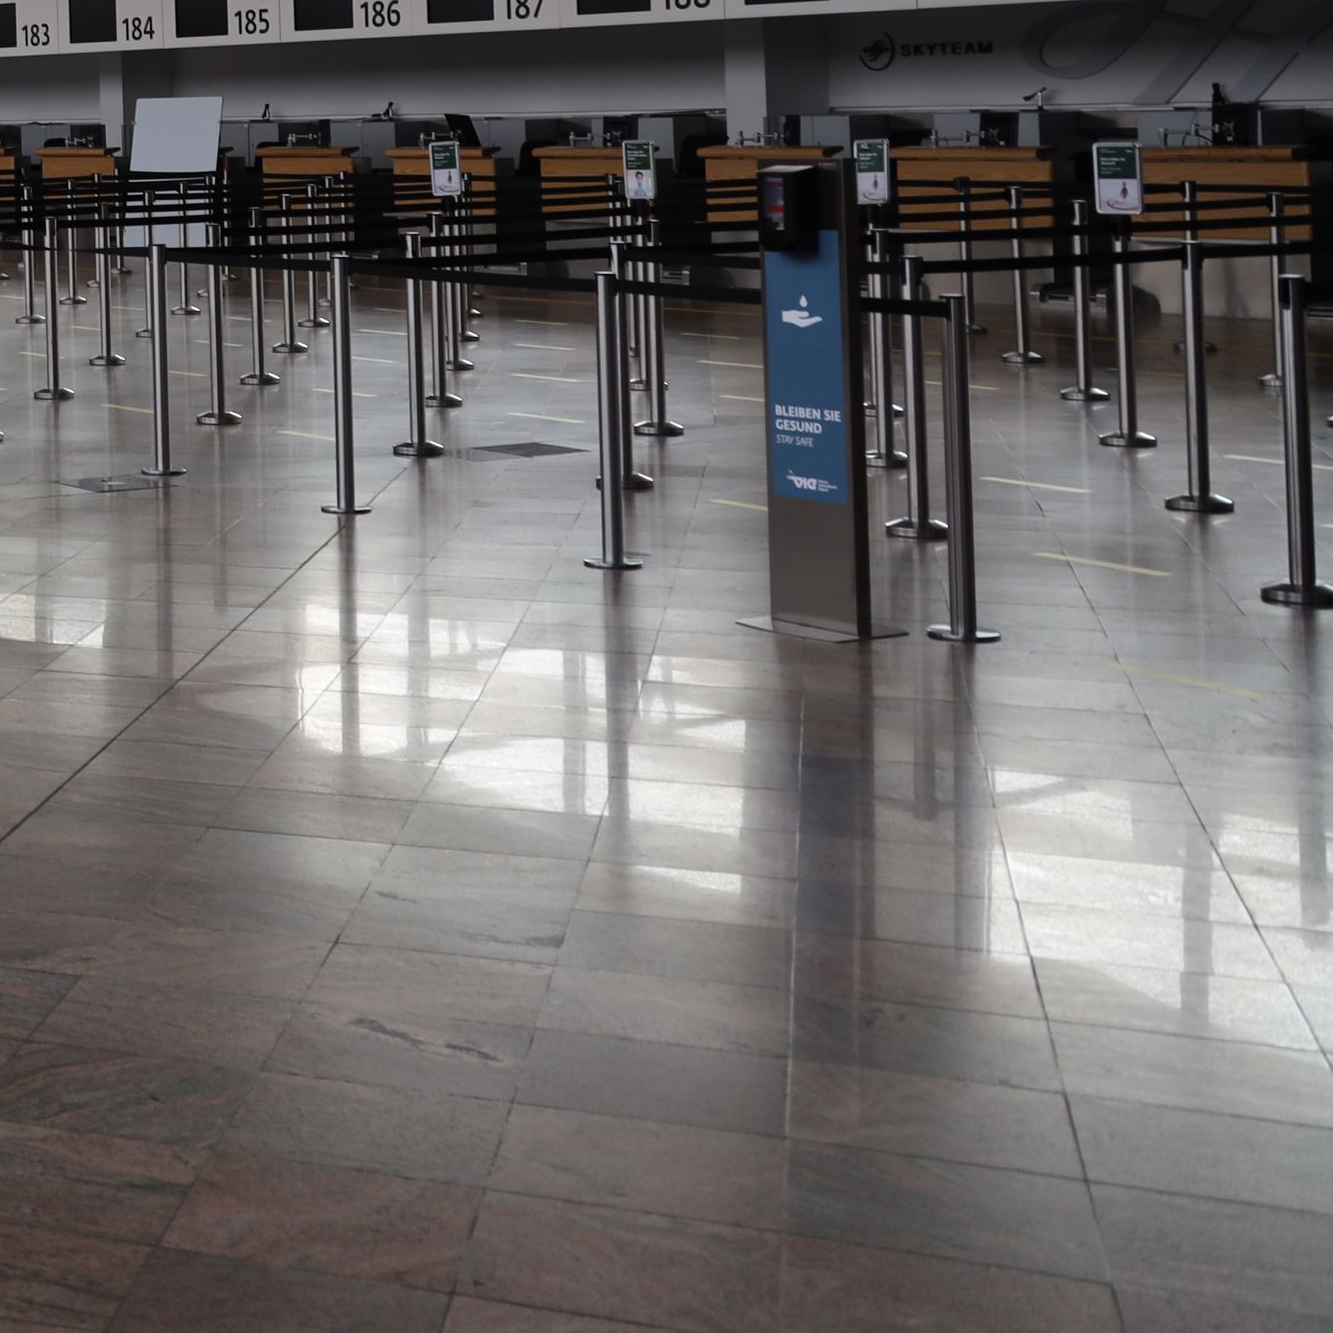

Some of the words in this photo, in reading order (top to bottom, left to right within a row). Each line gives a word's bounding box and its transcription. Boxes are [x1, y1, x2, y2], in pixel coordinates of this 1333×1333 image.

[235, 9, 269, 34] 185
[361, 0, 400, 27] 186
[22, 24, 49, 46] 183
[122, 17, 154, 40] 184
[901, 42, 993, 57] SKYTEAM
[775, 404, 821, 420] BLEIBEN
[823, 409, 842, 422] SIE
[775, 419, 823, 434] GESUND
[776, 434, 794, 444] STAY
[795, 436, 814, 448] SAFE
